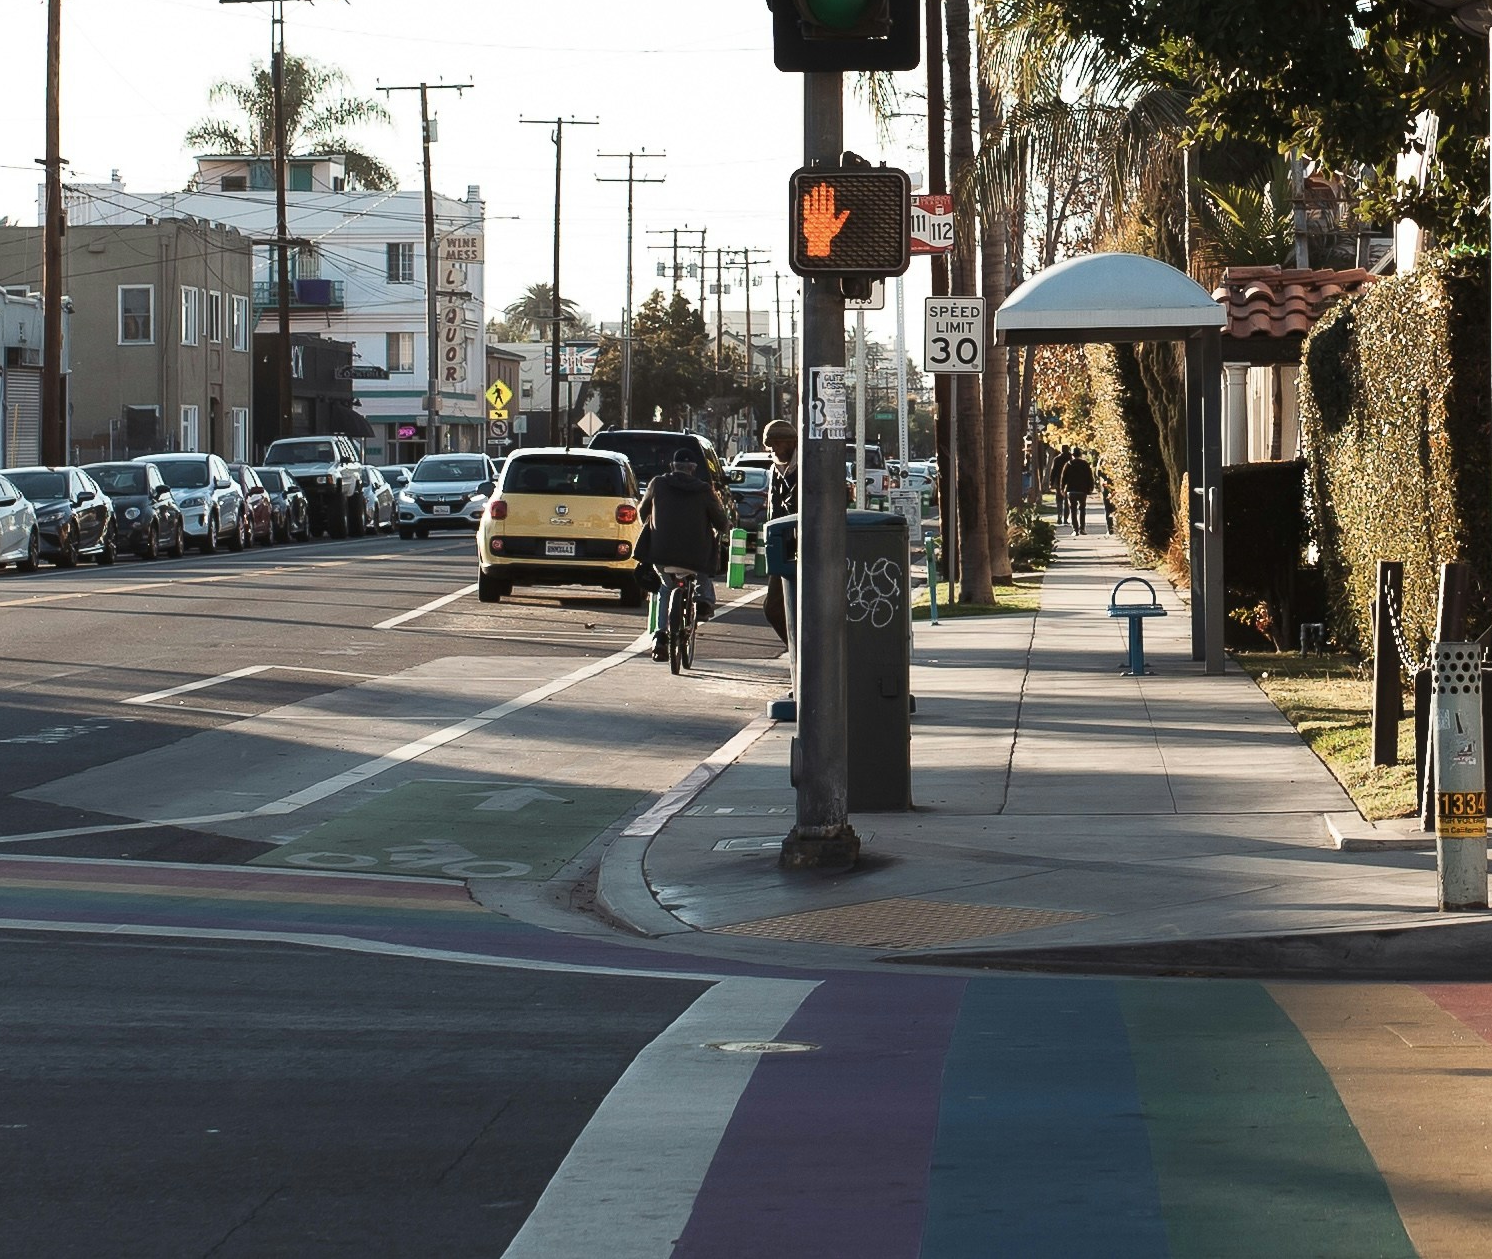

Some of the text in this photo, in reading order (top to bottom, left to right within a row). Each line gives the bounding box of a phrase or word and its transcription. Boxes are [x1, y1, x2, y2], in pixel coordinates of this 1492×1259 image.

[911, 214, 926, 233] 111
[931, 222, 953, 241] 112
[446, 238, 477, 248] WINE
[445, 250, 478, 260] MESS
[929, 306, 980, 318] SPEED
[936, 321, 974, 333] LIMIT
[929, 336, 978, 365] 30
